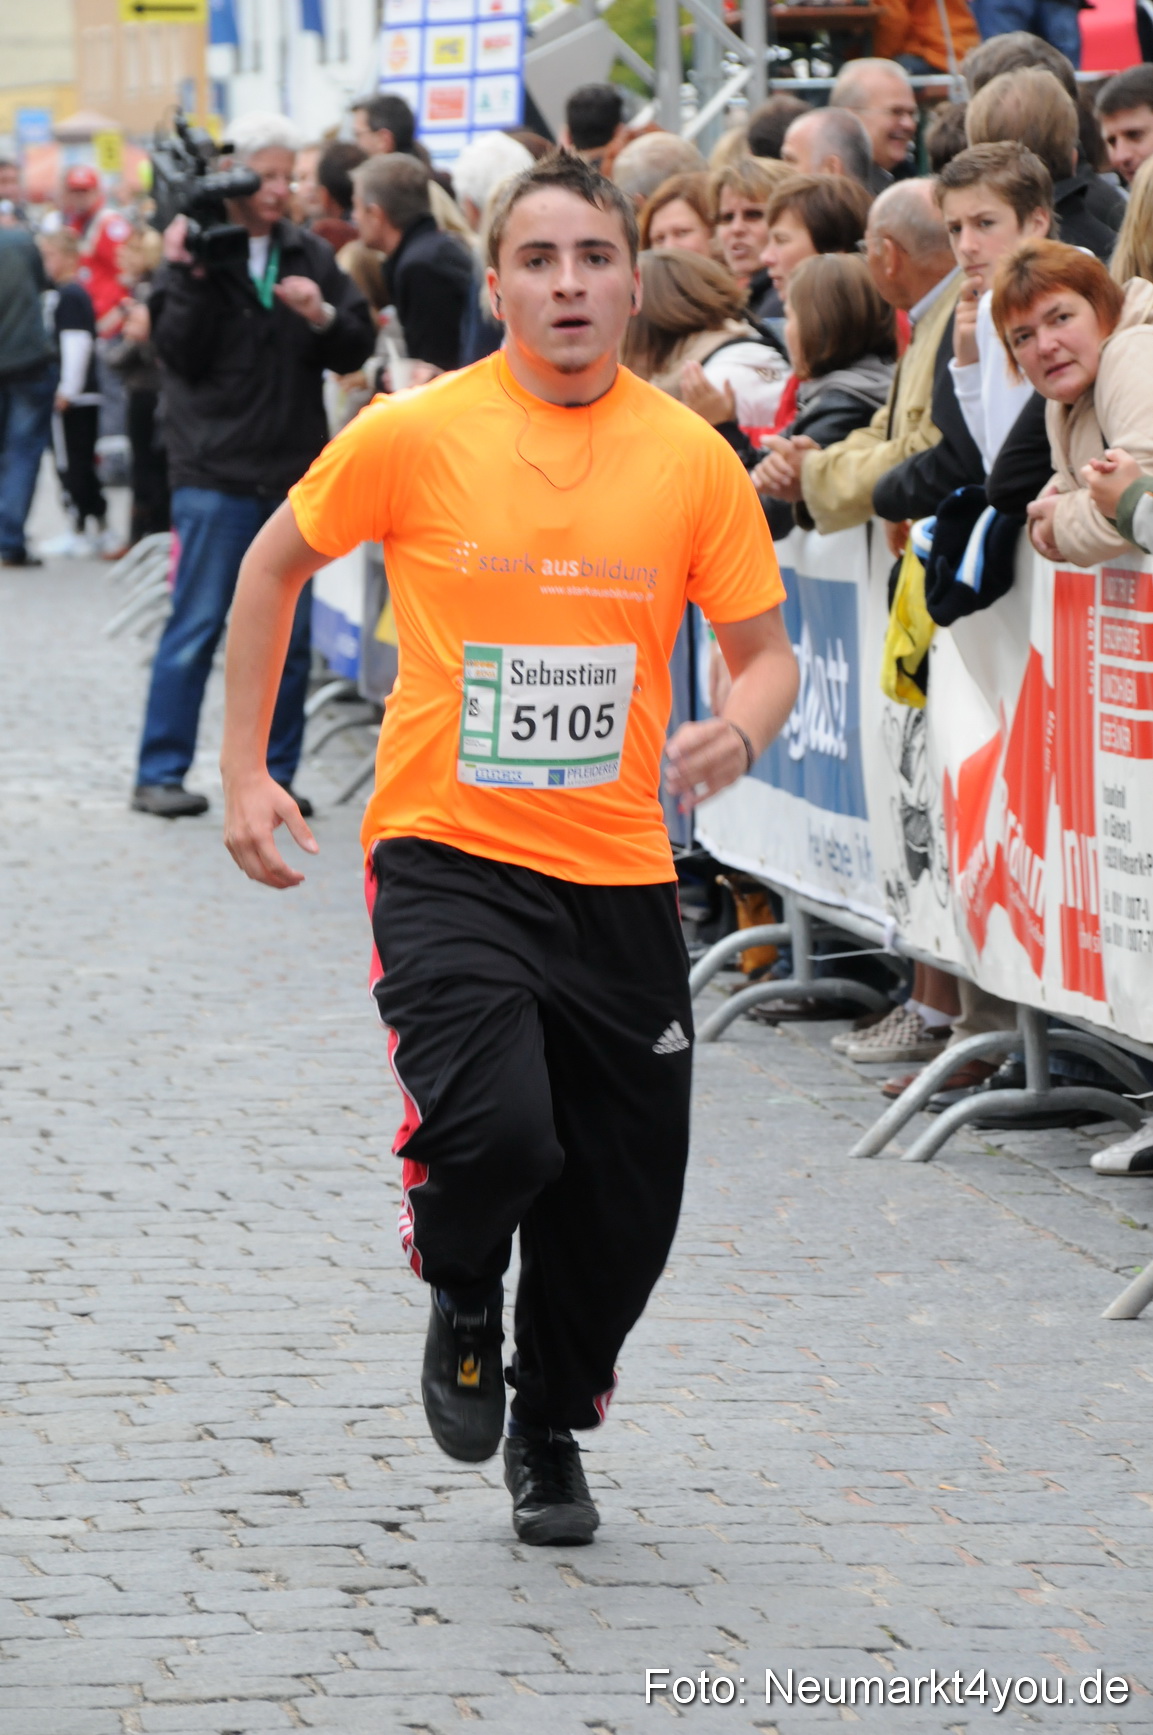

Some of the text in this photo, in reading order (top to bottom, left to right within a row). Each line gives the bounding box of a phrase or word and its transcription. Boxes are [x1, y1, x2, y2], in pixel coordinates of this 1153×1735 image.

[479, 553, 659, 589] stark ausbildung
[510, 659, 617, 686] Sebastian
[511, 703, 615, 741] 5105
